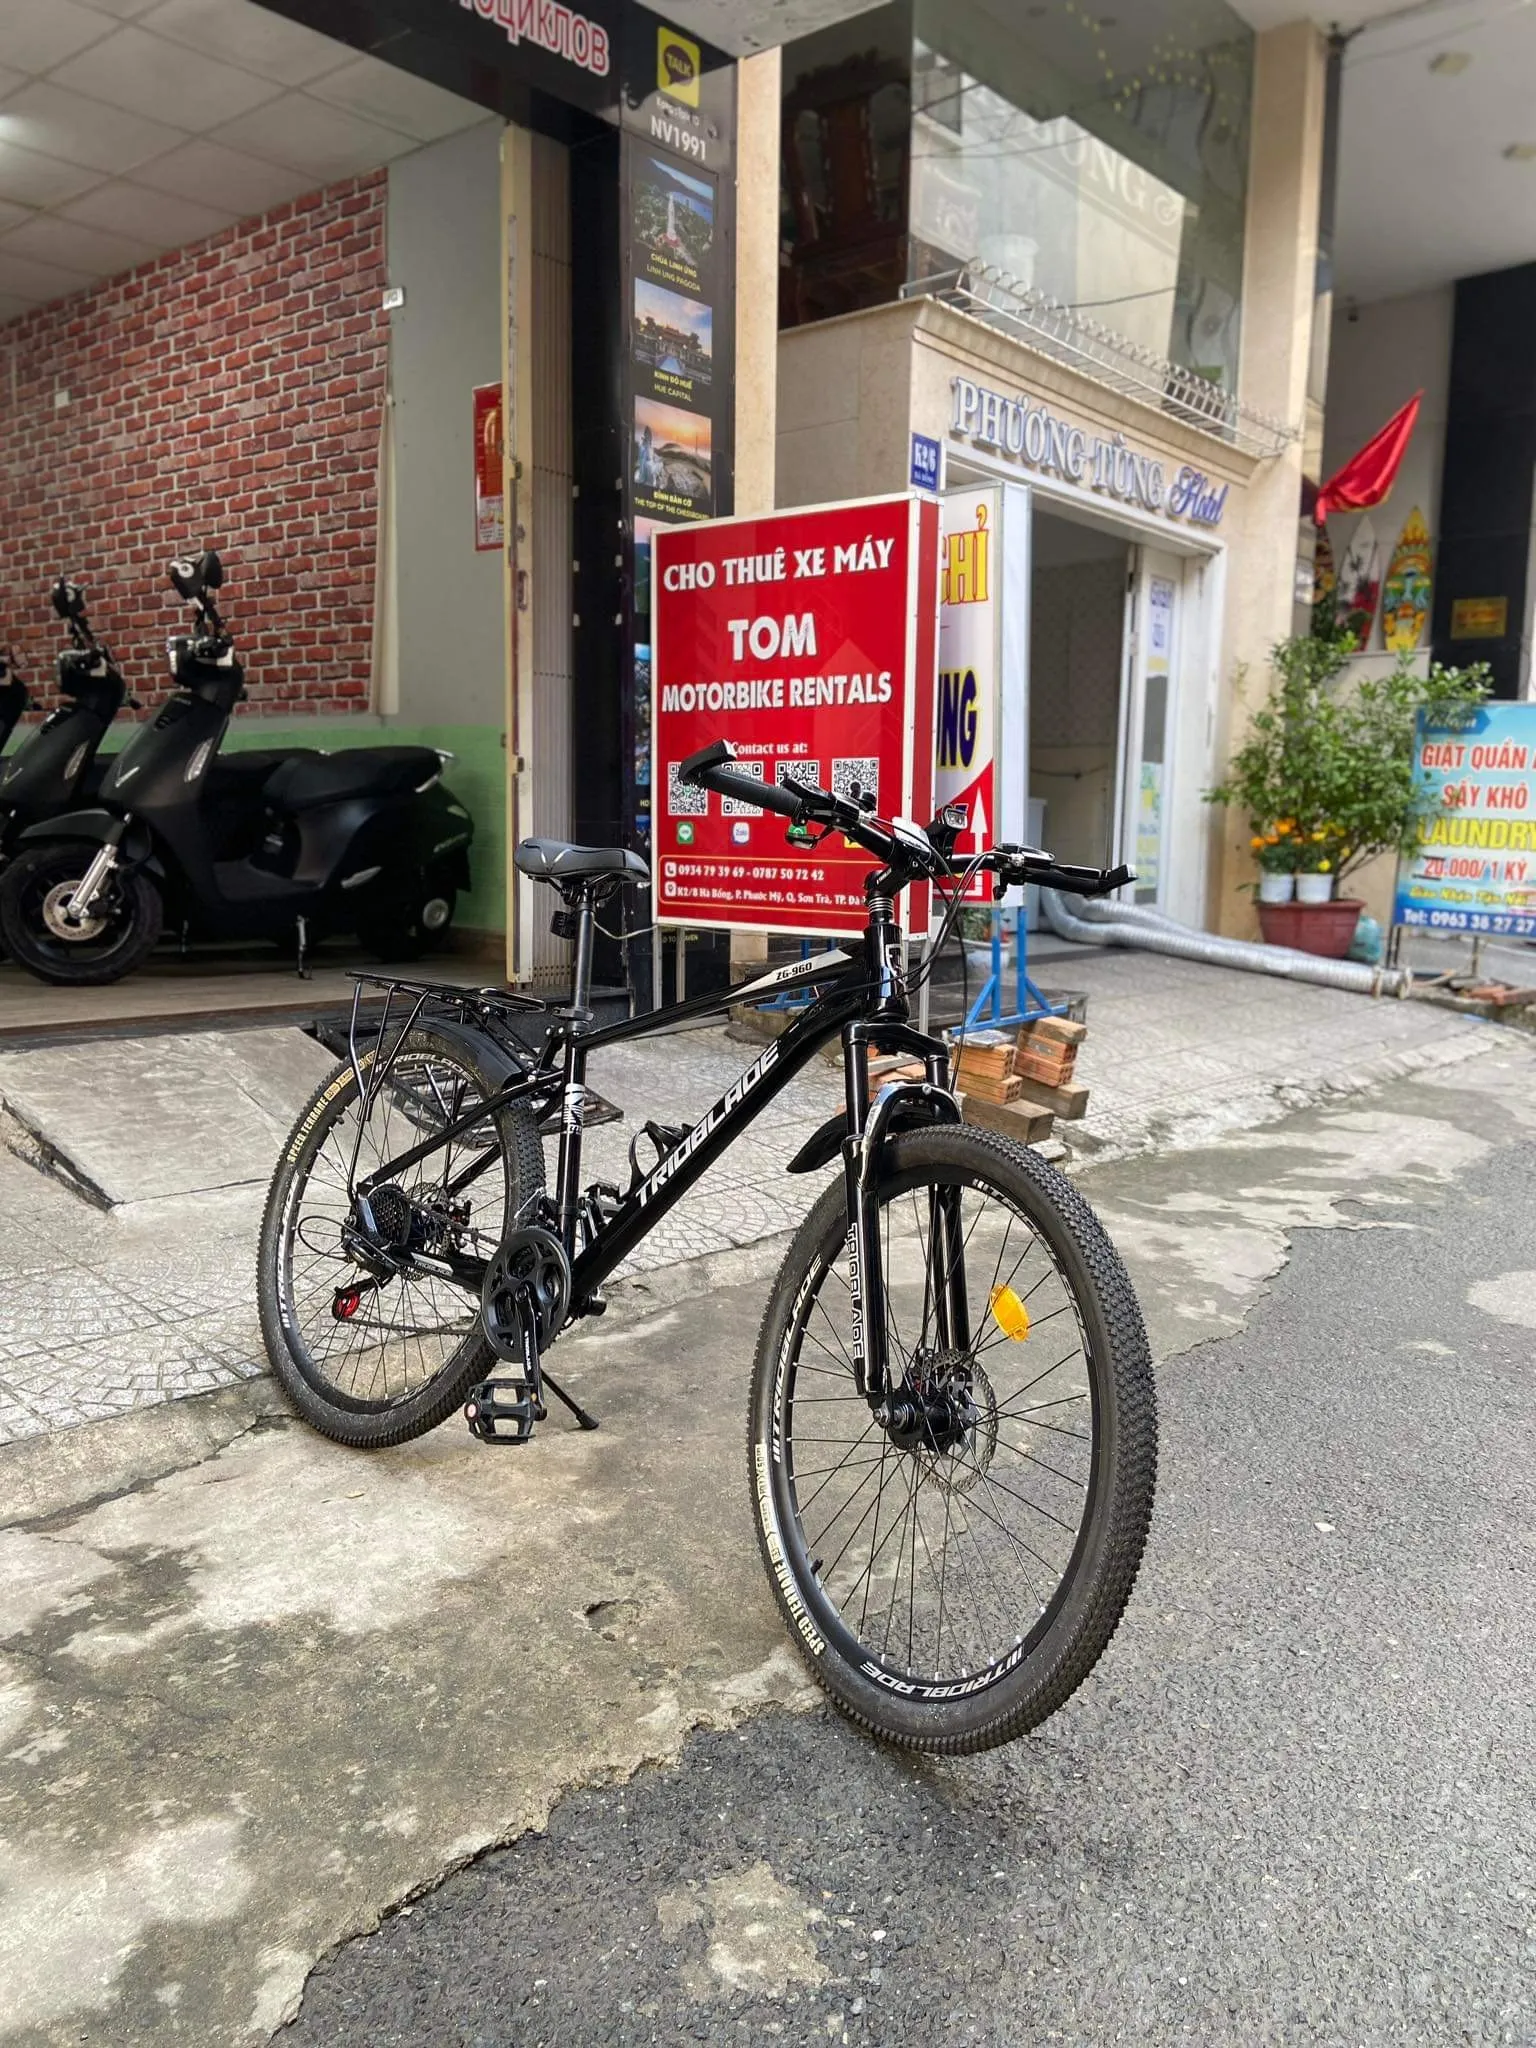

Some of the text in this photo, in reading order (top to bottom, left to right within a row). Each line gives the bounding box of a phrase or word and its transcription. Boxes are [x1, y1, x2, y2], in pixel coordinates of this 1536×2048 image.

[651, 115, 706, 161] NV1991
[952, 376, 1087, 480] PHƯƠNG
[1094, 432, 1165, 510] TÙNG
[663, 534, 895, 592] CHO THUÊ XE MÁY
[727, 612, 817, 661] TOM
[661, 671, 892, 712] MOTORBIKE RENTALS
[730, 740, 808, 756] Contact us at:
[1486, 782, 1528, 811] KHÔ
[678, 864, 701, 876] 0934
[703, 864, 716, 877] 79
[718, 865, 730, 878] 39
[732, 866, 744, 878] 69
[752, 866, 778, 879] 0787
[780, 867, 794, 880] 50
[795, 868, 809, 881] 72
[810, 869, 825, 881] 42
[1403, 908, 1428, 924] Tel:
[1430, 910, 1467, 928] 0963
[287, 1134, 304, 1162] SPEED
[797, 1616, 825, 1656] SPEED
